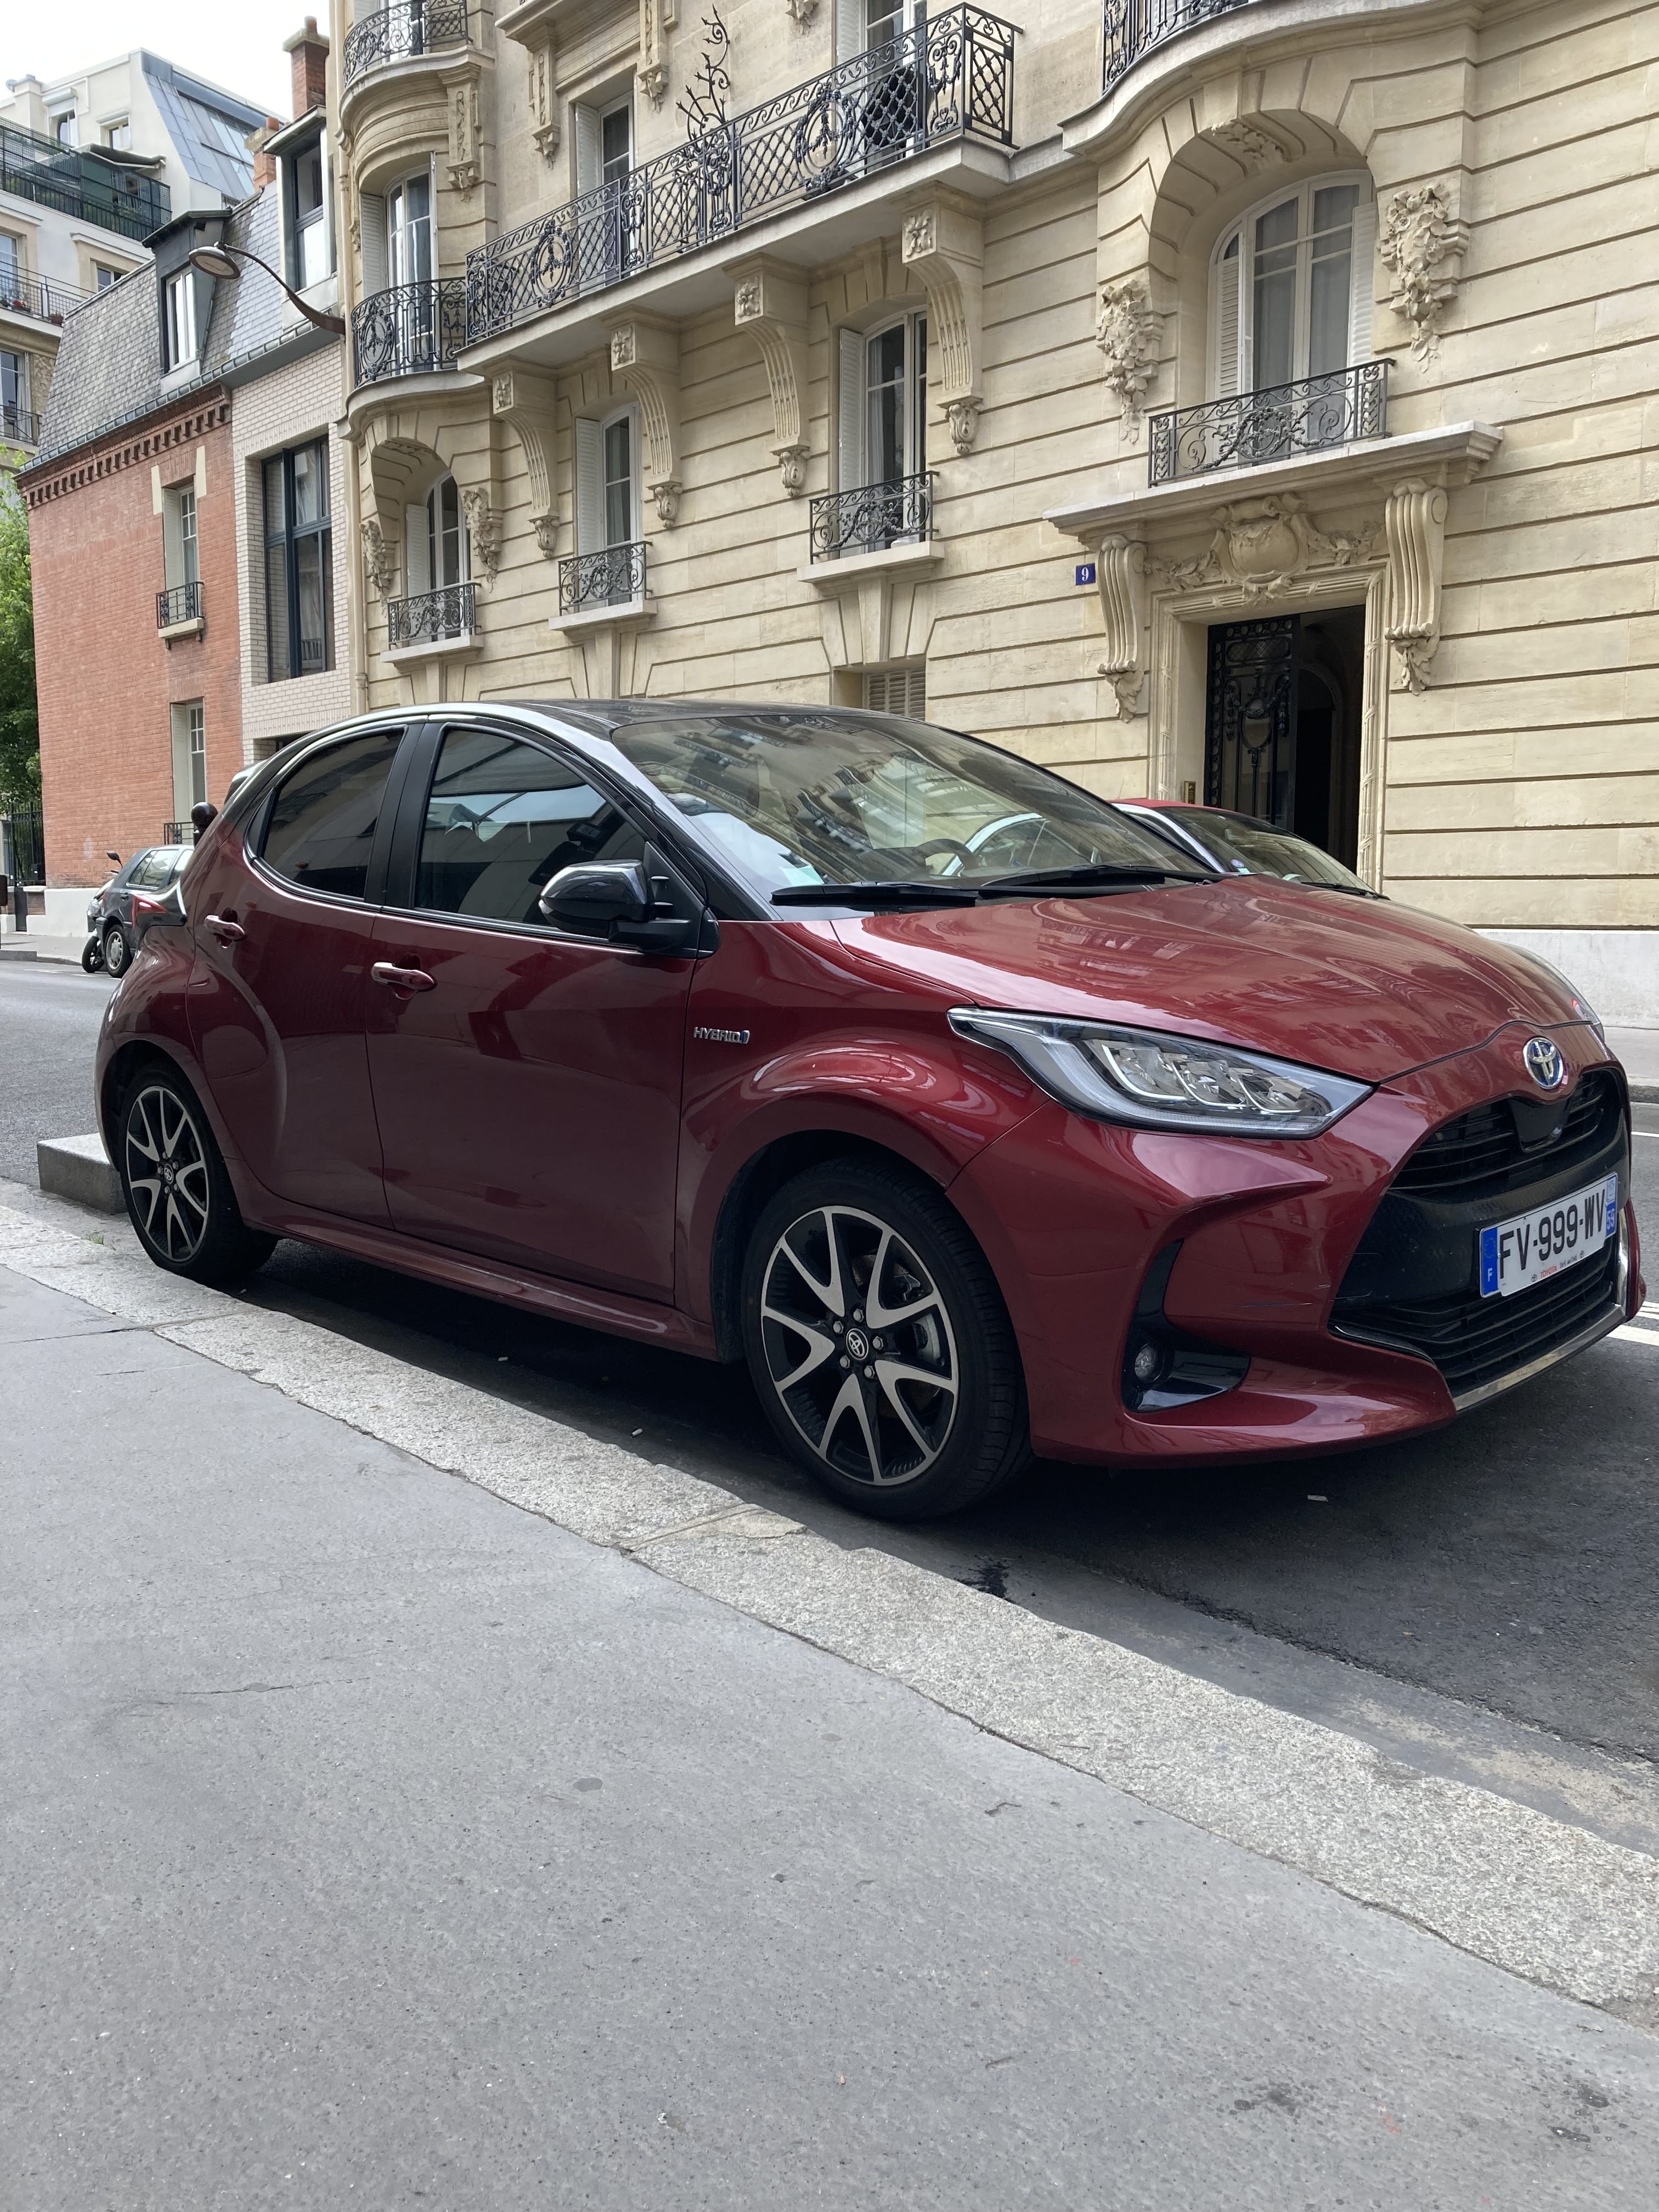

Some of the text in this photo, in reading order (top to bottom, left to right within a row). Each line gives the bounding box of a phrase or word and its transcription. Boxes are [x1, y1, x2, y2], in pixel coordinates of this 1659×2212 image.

[1081, 567, 1089, 582] 9
[693, 1026, 741, 1043] HYBRID
[1499, 1189, 1605, 1279] FV-999-WV
[1487, 1267, 1493, 1282] F
